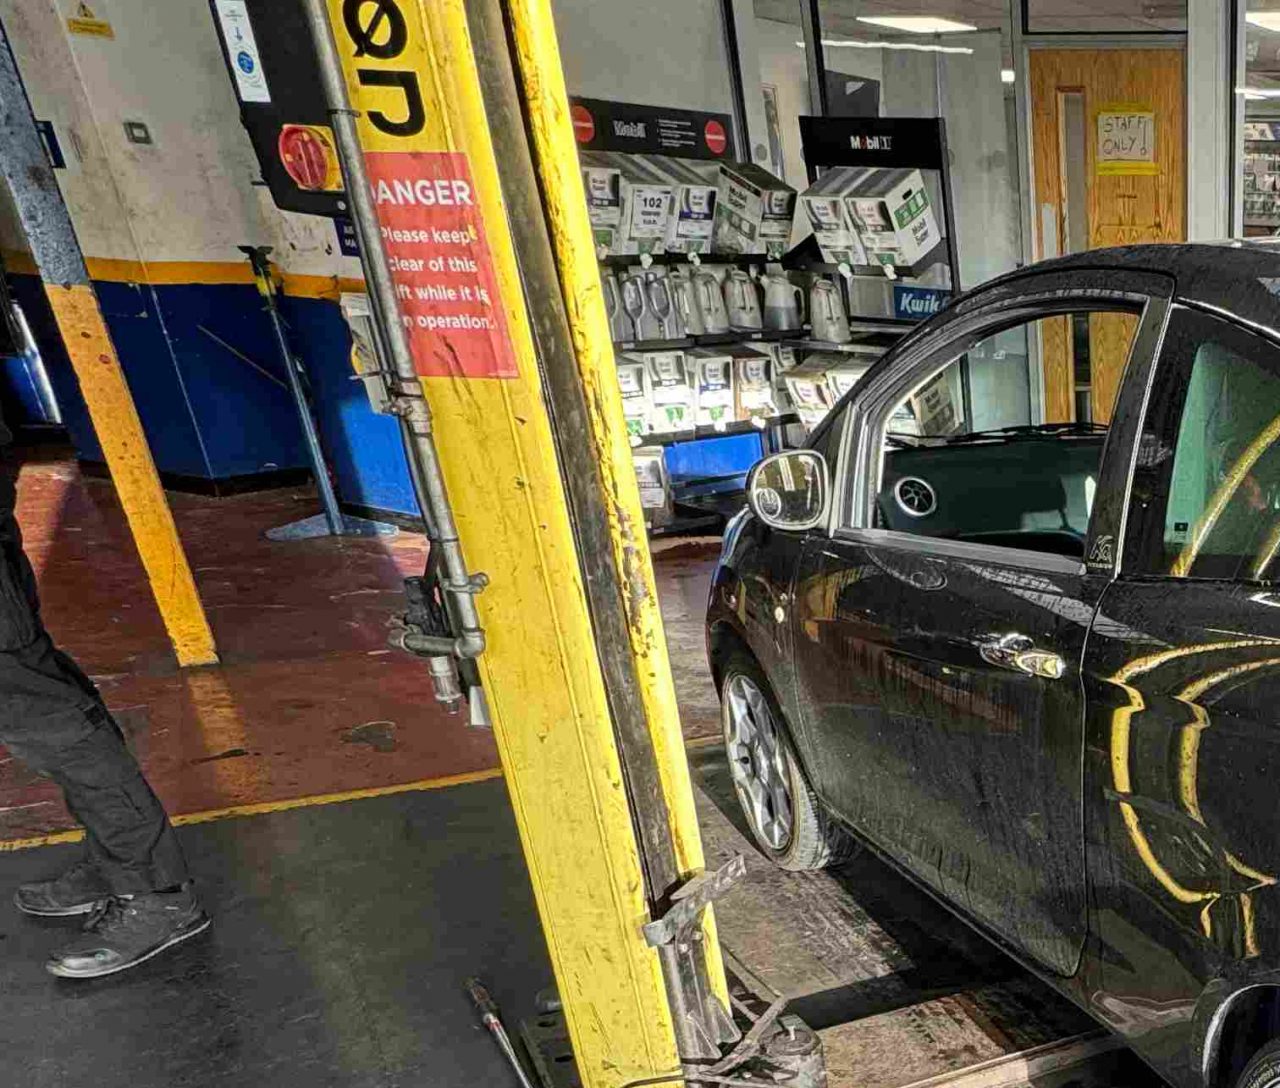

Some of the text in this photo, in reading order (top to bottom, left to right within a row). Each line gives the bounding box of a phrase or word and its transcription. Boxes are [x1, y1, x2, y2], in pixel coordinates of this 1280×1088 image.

[1103, 115, 1146, 132] STAFF
[850, 136, 879, 150] Mobil
[371, 179, 474, 205] ANGER
[643, 197, 662, 208] 102
[432, 226, 470, 246] keep
[428, 256, 444, 272] of
[447, 256, 478, 272] this
[415, 284, 456, 300] while
[460, 286, 474, 301] it
[475, 287, 490, 303] is
[900, 293, 939, 314] Kwik
[417, 314, 496, 332] operation.
